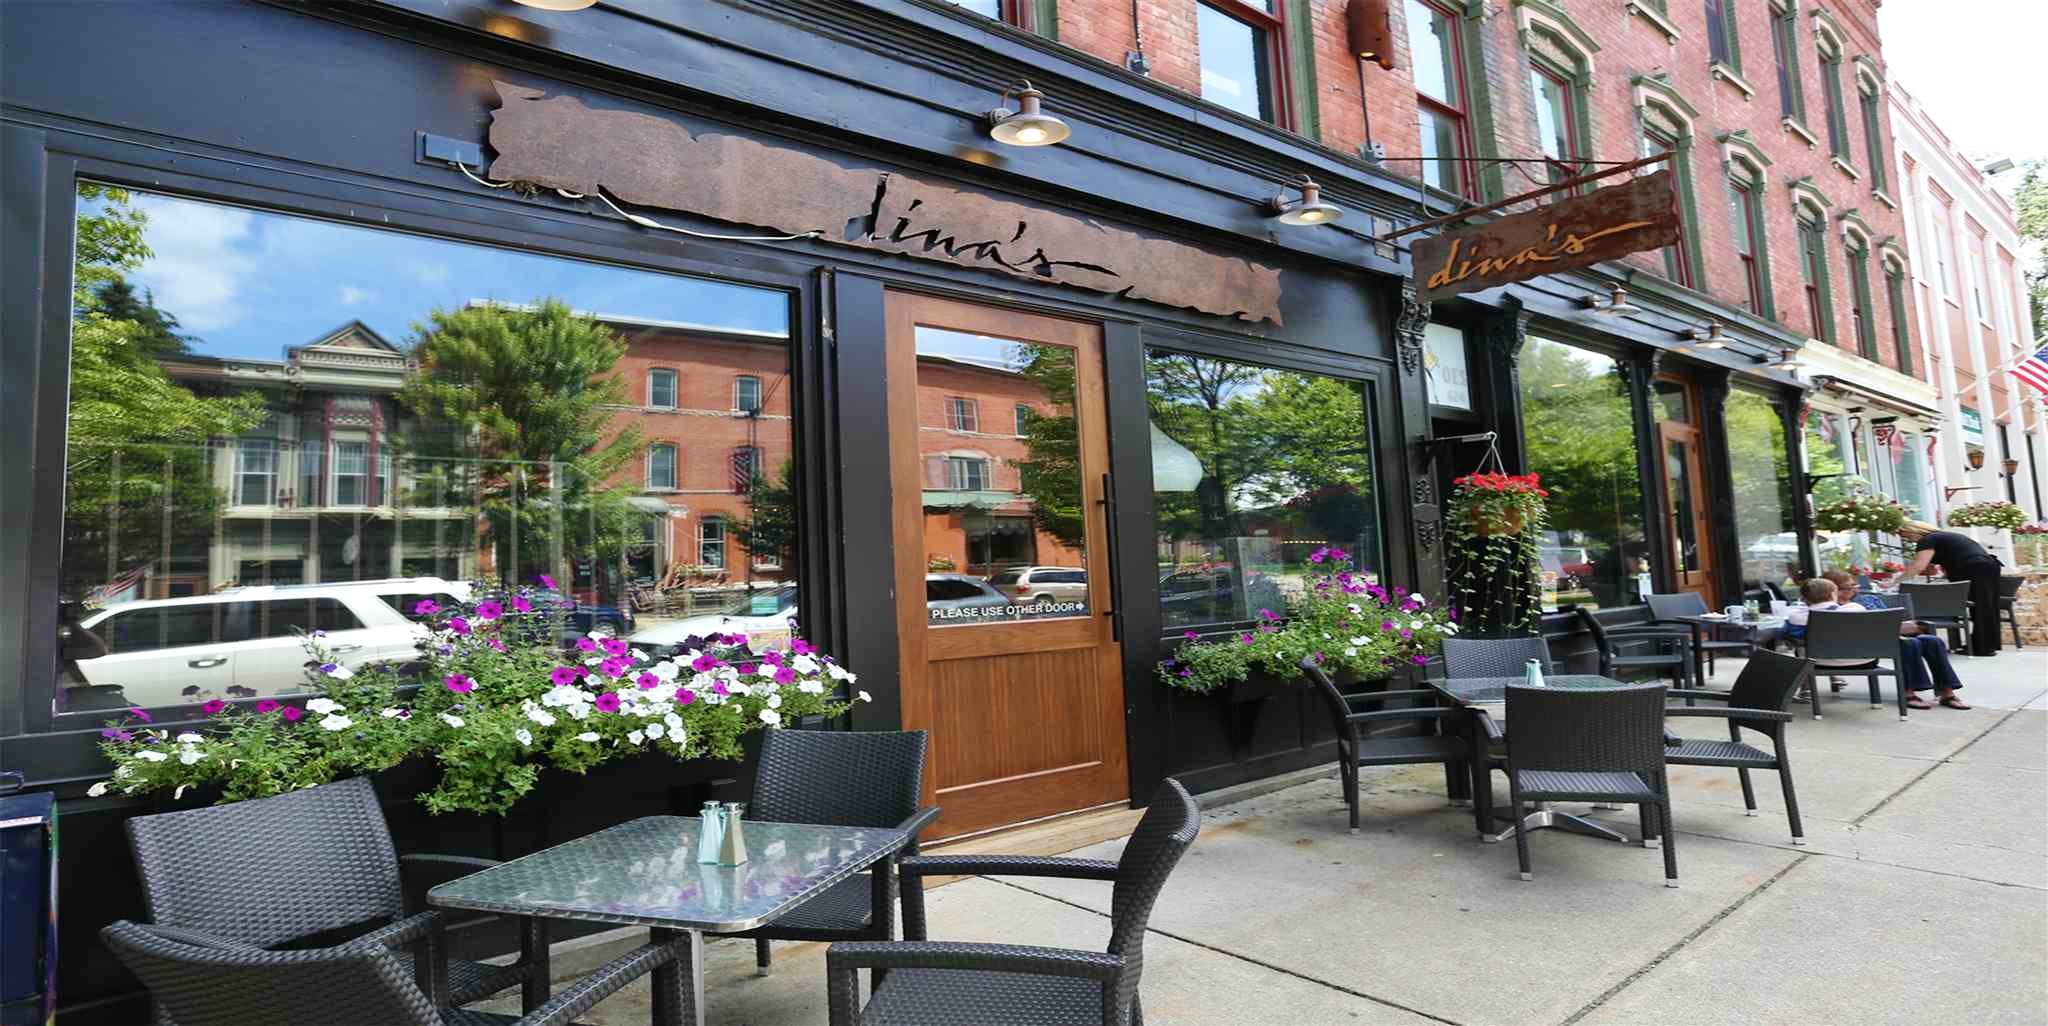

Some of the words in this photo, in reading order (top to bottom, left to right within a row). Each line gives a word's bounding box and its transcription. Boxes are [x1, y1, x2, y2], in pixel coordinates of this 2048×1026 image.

[844, 173, 1120, 278] dina's
[1427, 221, 1653, 289] dina's
[932, 607, 978, 619] PLEASE
[981, 606, 1004, 617] USE
[1006, 604, 1042, 615] OTHER
[1045, 602, 1076, 613] DOOR
